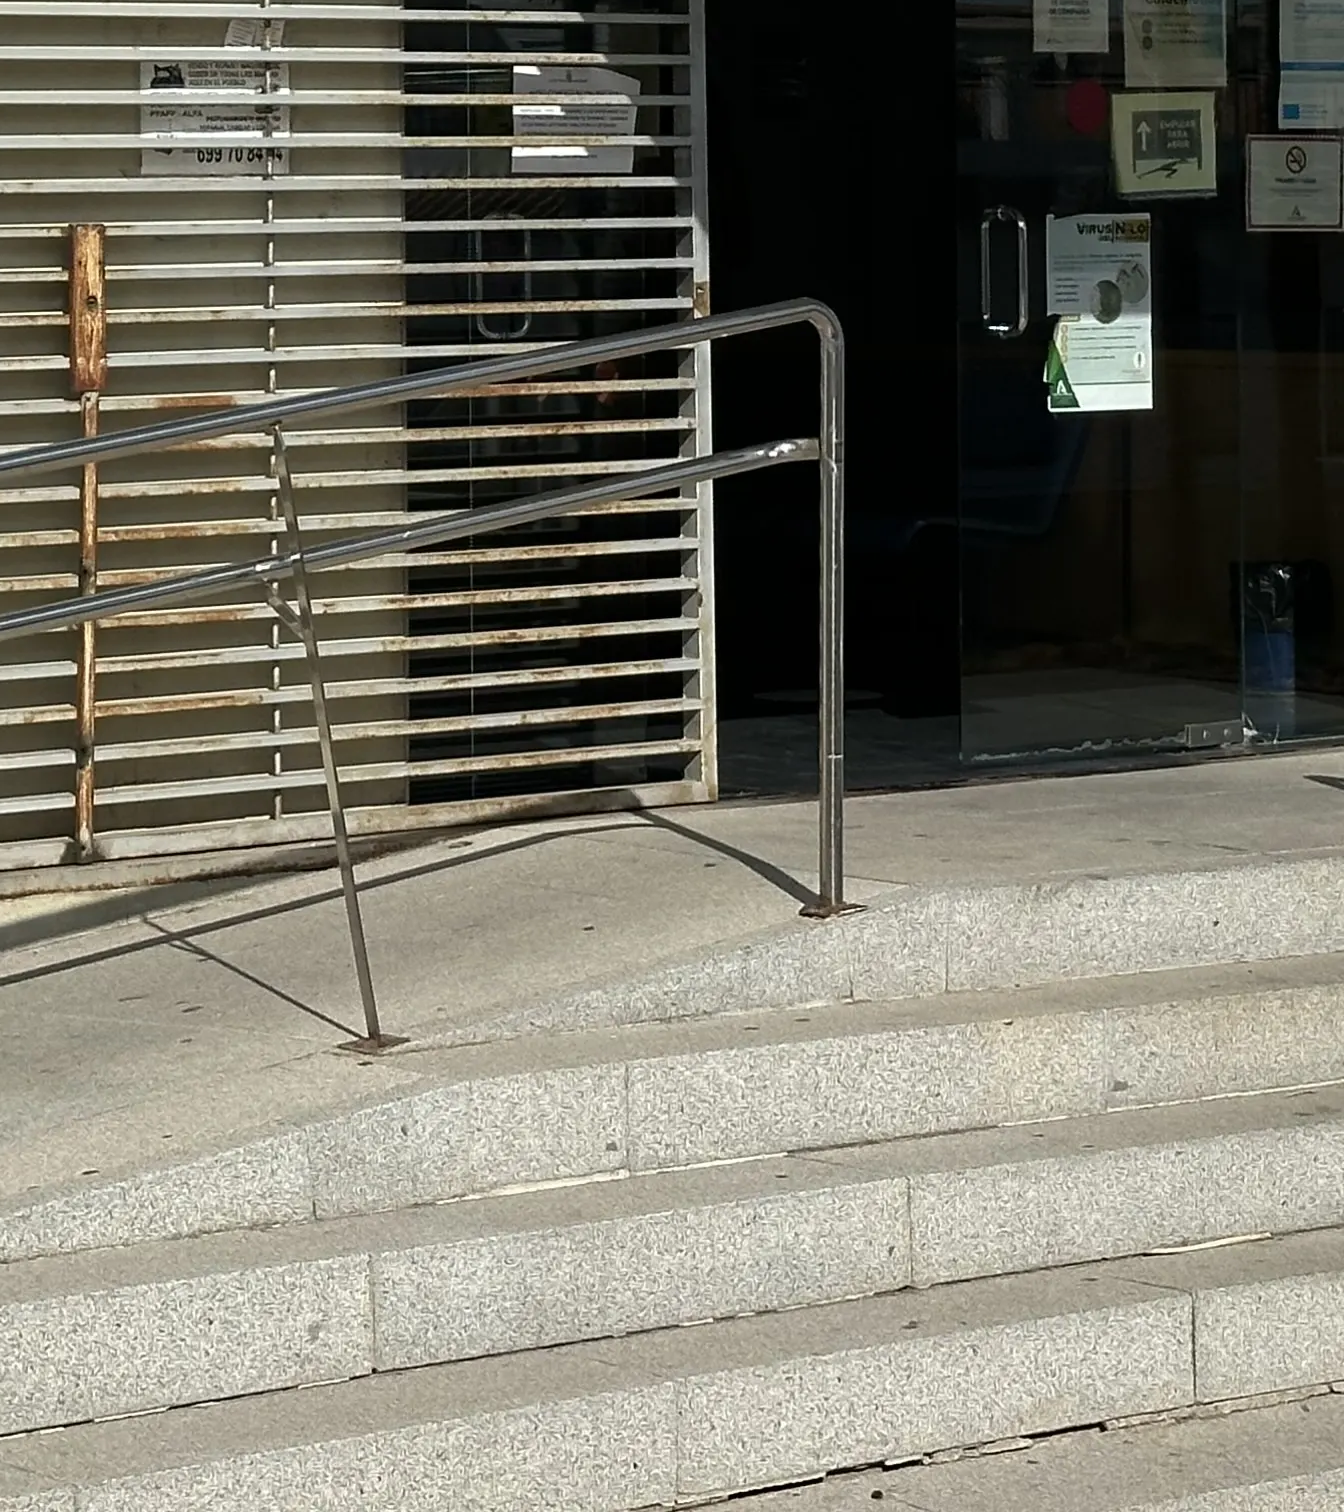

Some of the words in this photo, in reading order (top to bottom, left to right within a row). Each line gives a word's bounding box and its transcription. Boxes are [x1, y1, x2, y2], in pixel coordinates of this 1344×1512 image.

[197, 148, 222, 163] 699
[1076, 222, 1112, 235] VIRUS
[1115, 222, 1146, 235] NLO
